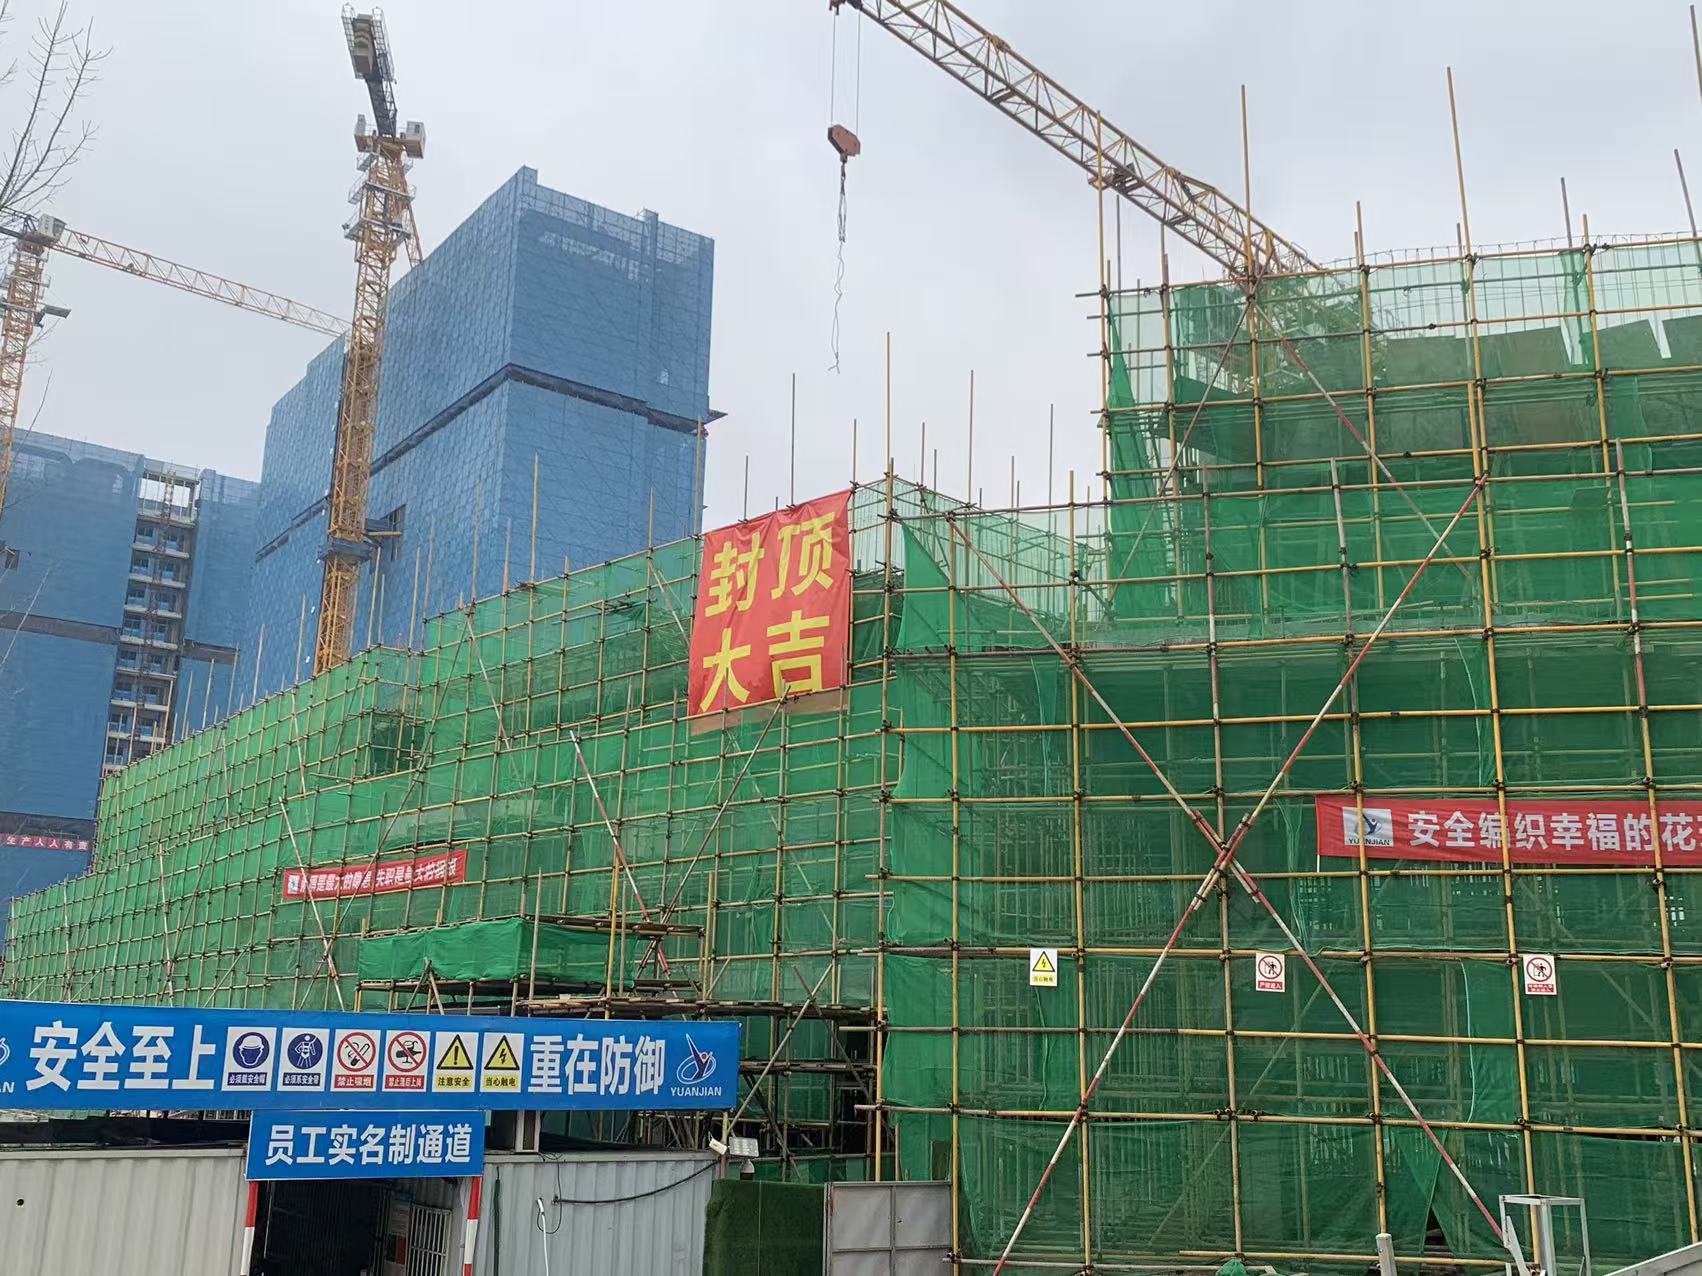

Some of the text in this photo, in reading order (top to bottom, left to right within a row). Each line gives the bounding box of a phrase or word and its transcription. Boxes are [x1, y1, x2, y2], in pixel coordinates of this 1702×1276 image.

[705, 511, 835, 617] 封顶
[700, 609, 830, 712] 大吉
[1348, 838, 1390, 846] YUNJIAN
[1407, 810, 1702, 851] 安全编织幸福的花
[26, 1020, 216, 1092] 安全至上
[527, 1032, 666, 1096] 重在防御
[337, 1076, 372, 1087] 禁止吸烟
[437, 1076, 470, 1087] 注意安全
[485, 1077, 516, 1087] 当心触电
[670, 1086, 722, 1097] YUANJIAN
[265, 1123, 472, 1166] 员工实名制通道
